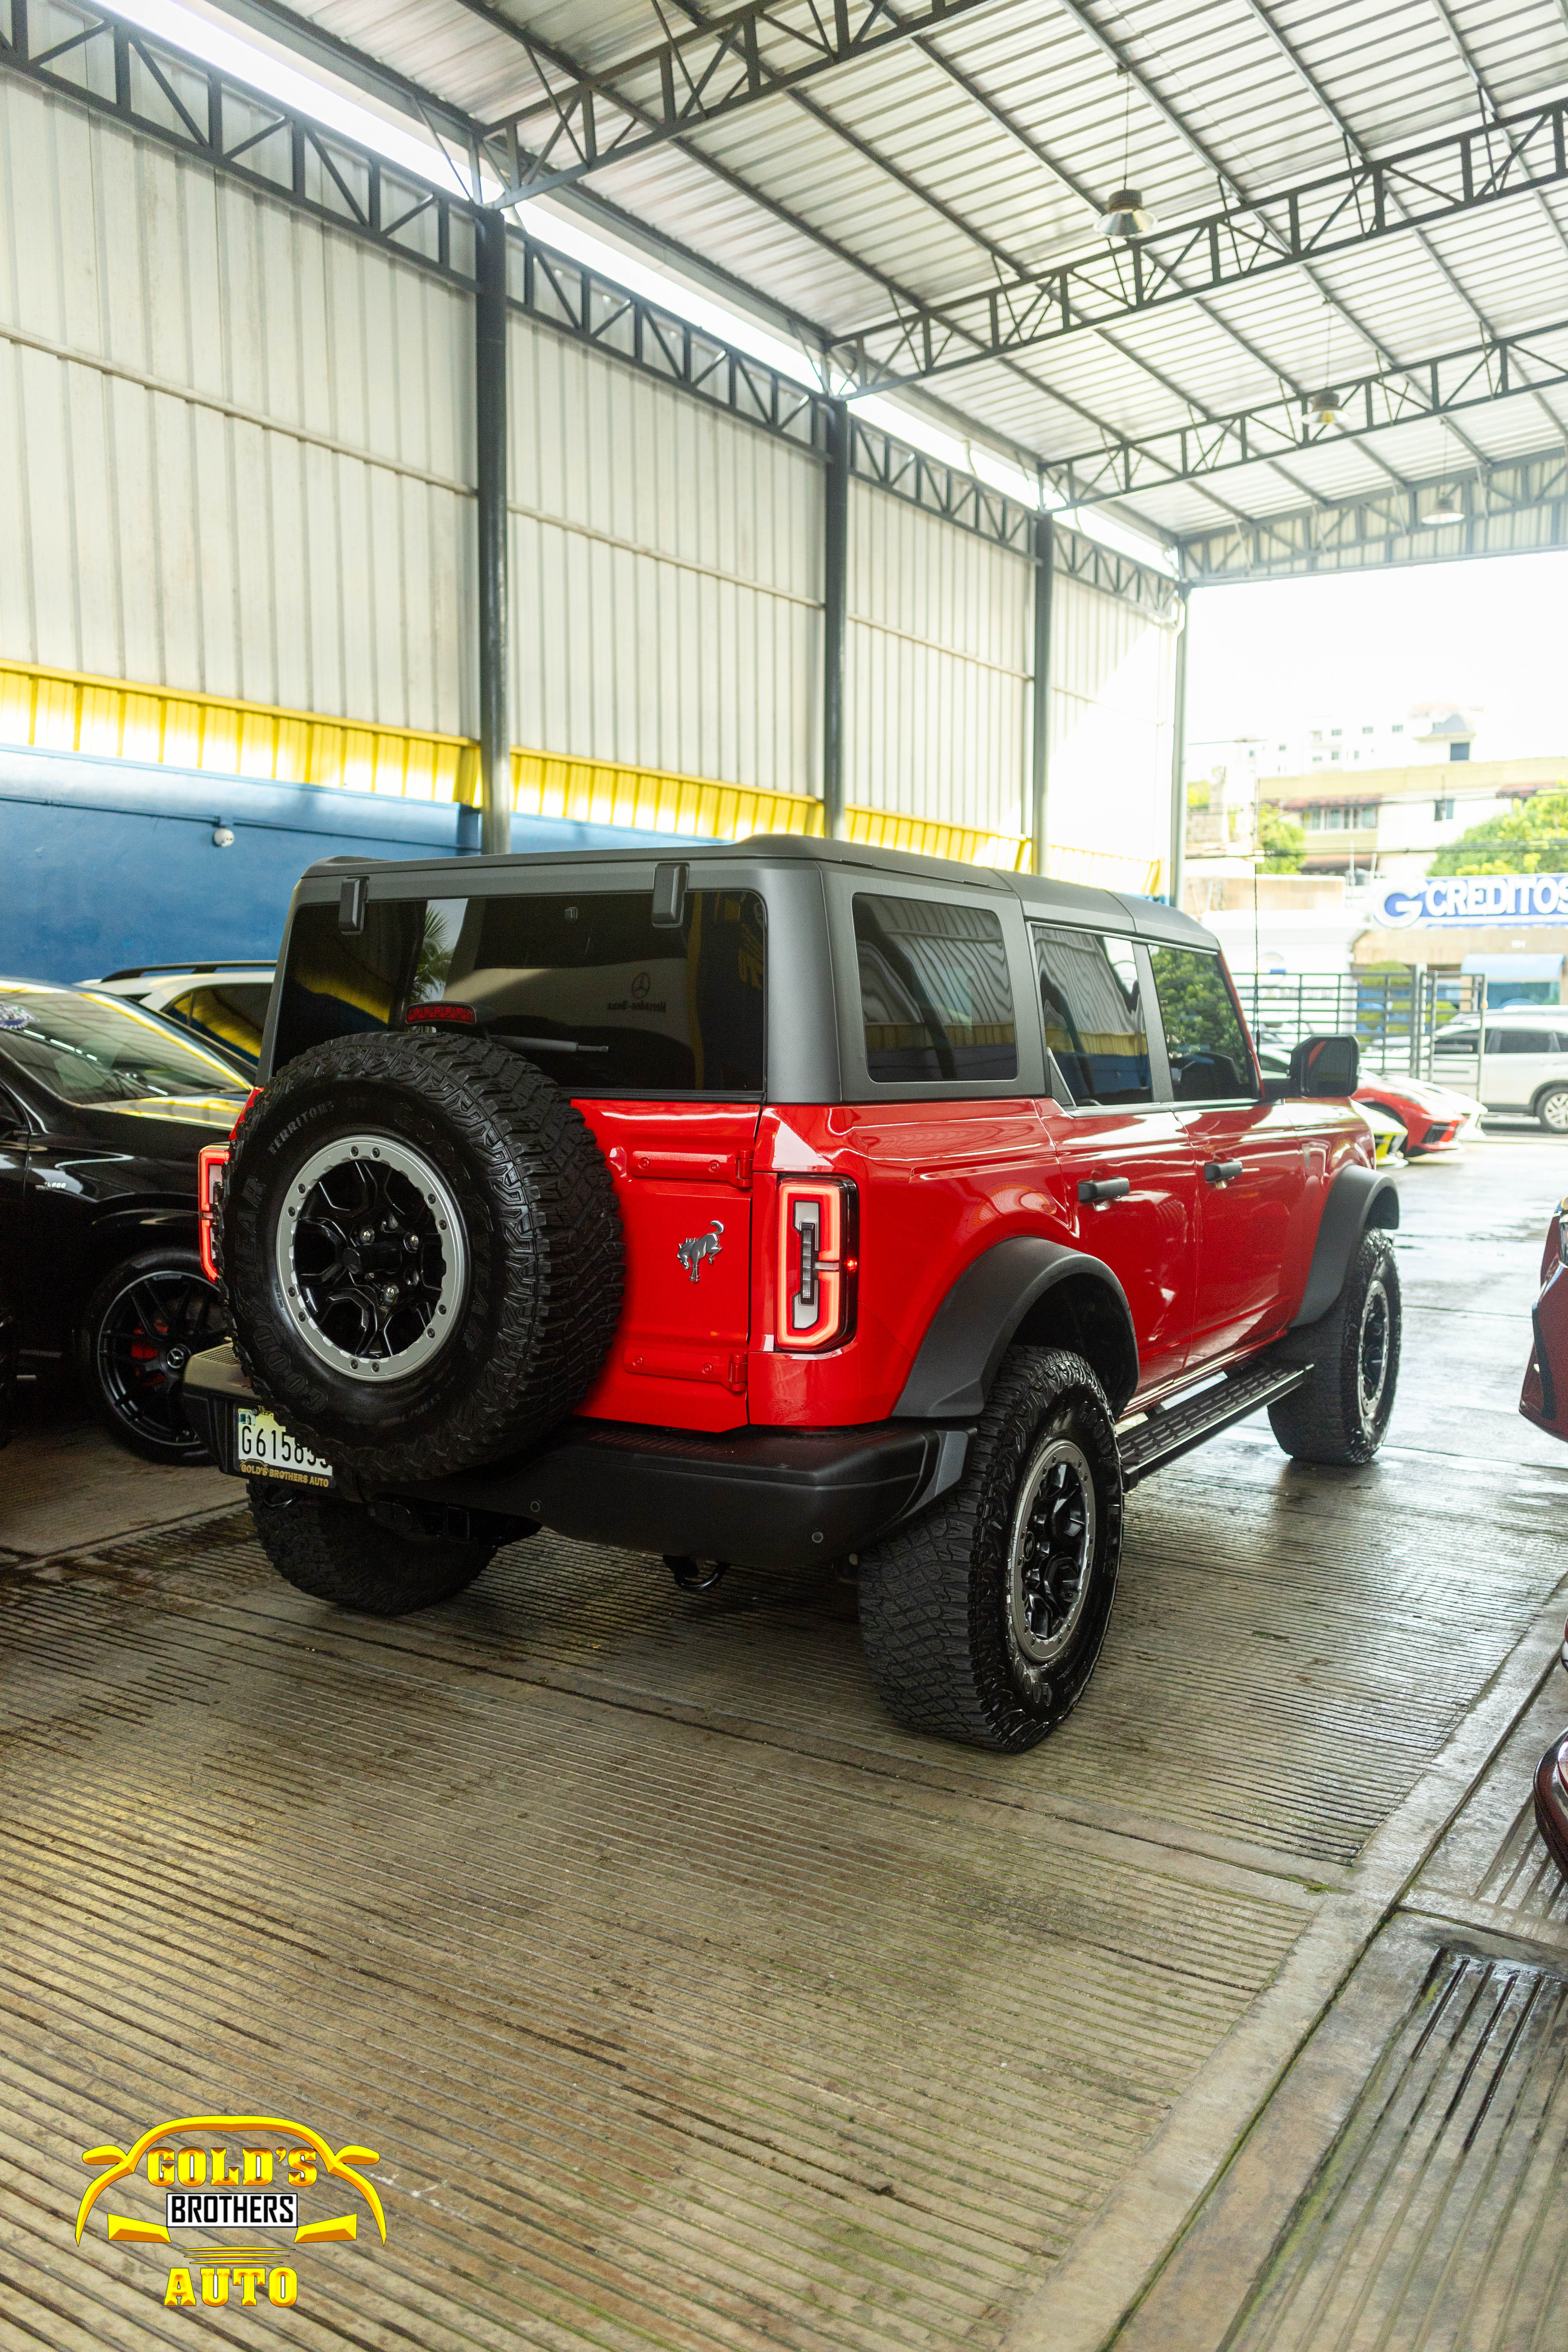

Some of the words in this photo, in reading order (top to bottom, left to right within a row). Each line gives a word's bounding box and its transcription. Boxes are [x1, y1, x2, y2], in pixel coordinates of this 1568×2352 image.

[241, 1464, 268, 1476] GOLD'S
[269, 1468, 308, 1484] BROTHERS
[309, 1476, 329, 1488] AUTO
